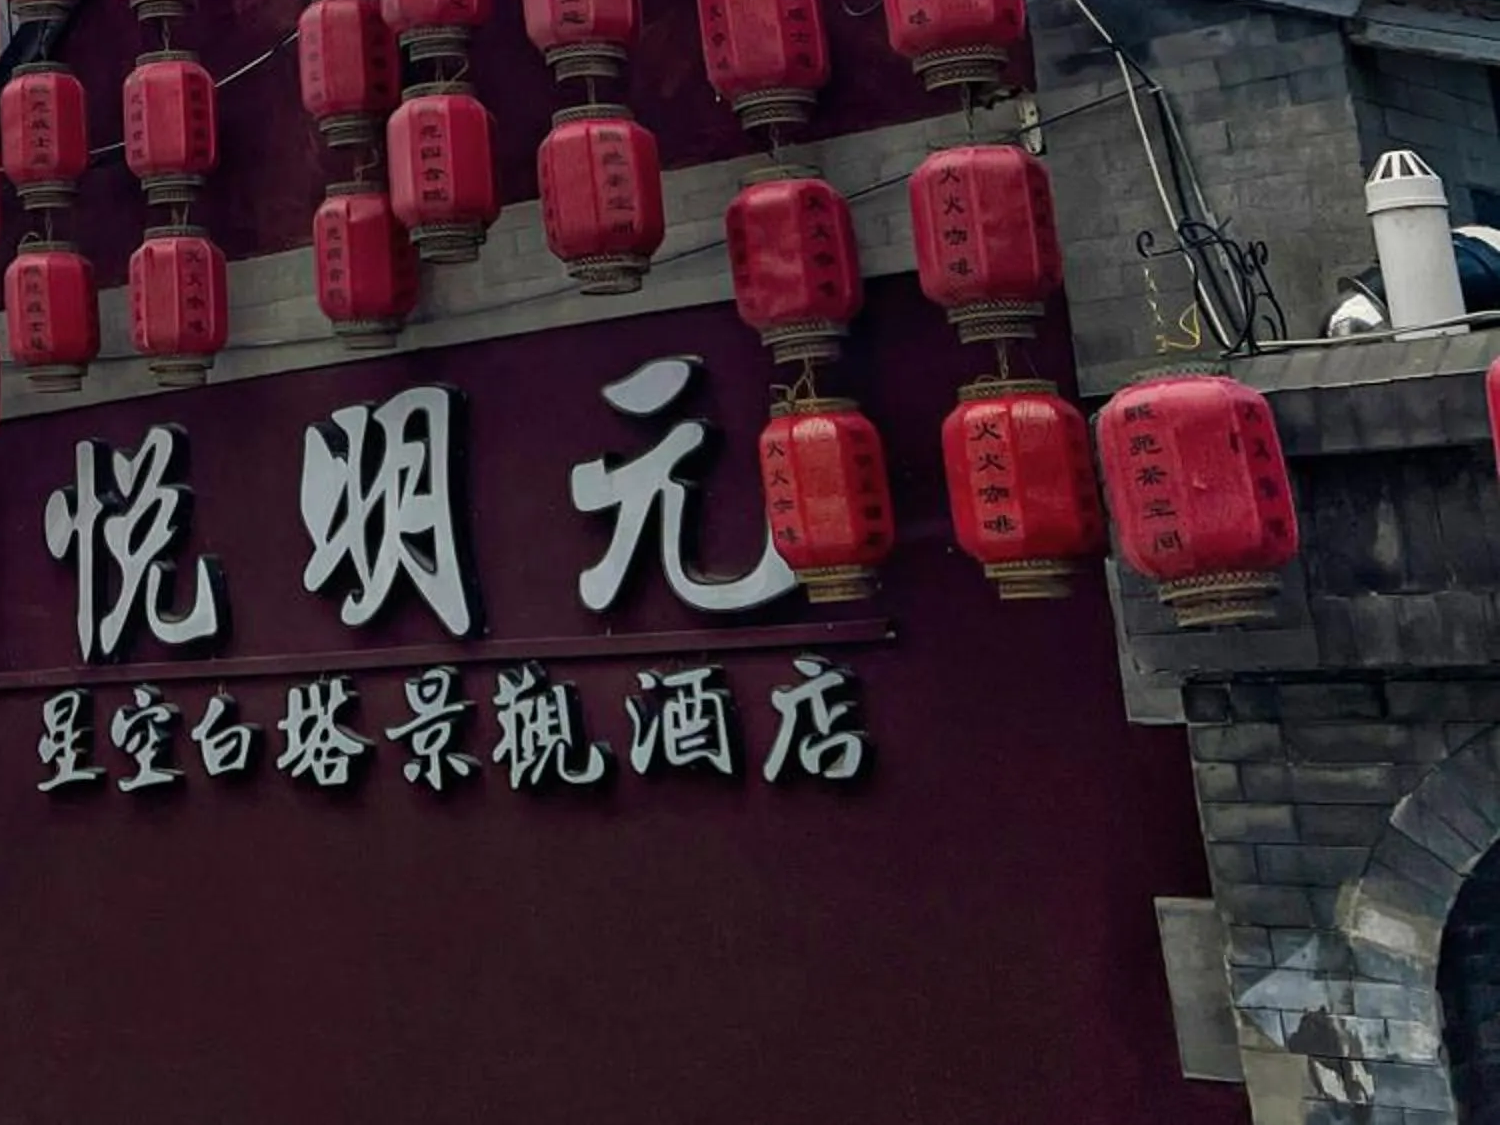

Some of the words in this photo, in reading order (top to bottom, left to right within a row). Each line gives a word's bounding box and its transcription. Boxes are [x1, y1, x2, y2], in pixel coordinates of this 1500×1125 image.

[940, 164, 974, 276] 火火咖啡
[45, 357, 798, 663] 悦明元
[766, 441, 801, 545] 火火咖啡
[970, 421, 1016, 535] 火火咖啡
[37, 656, 867, 793] 星空白塔景觀酒店
